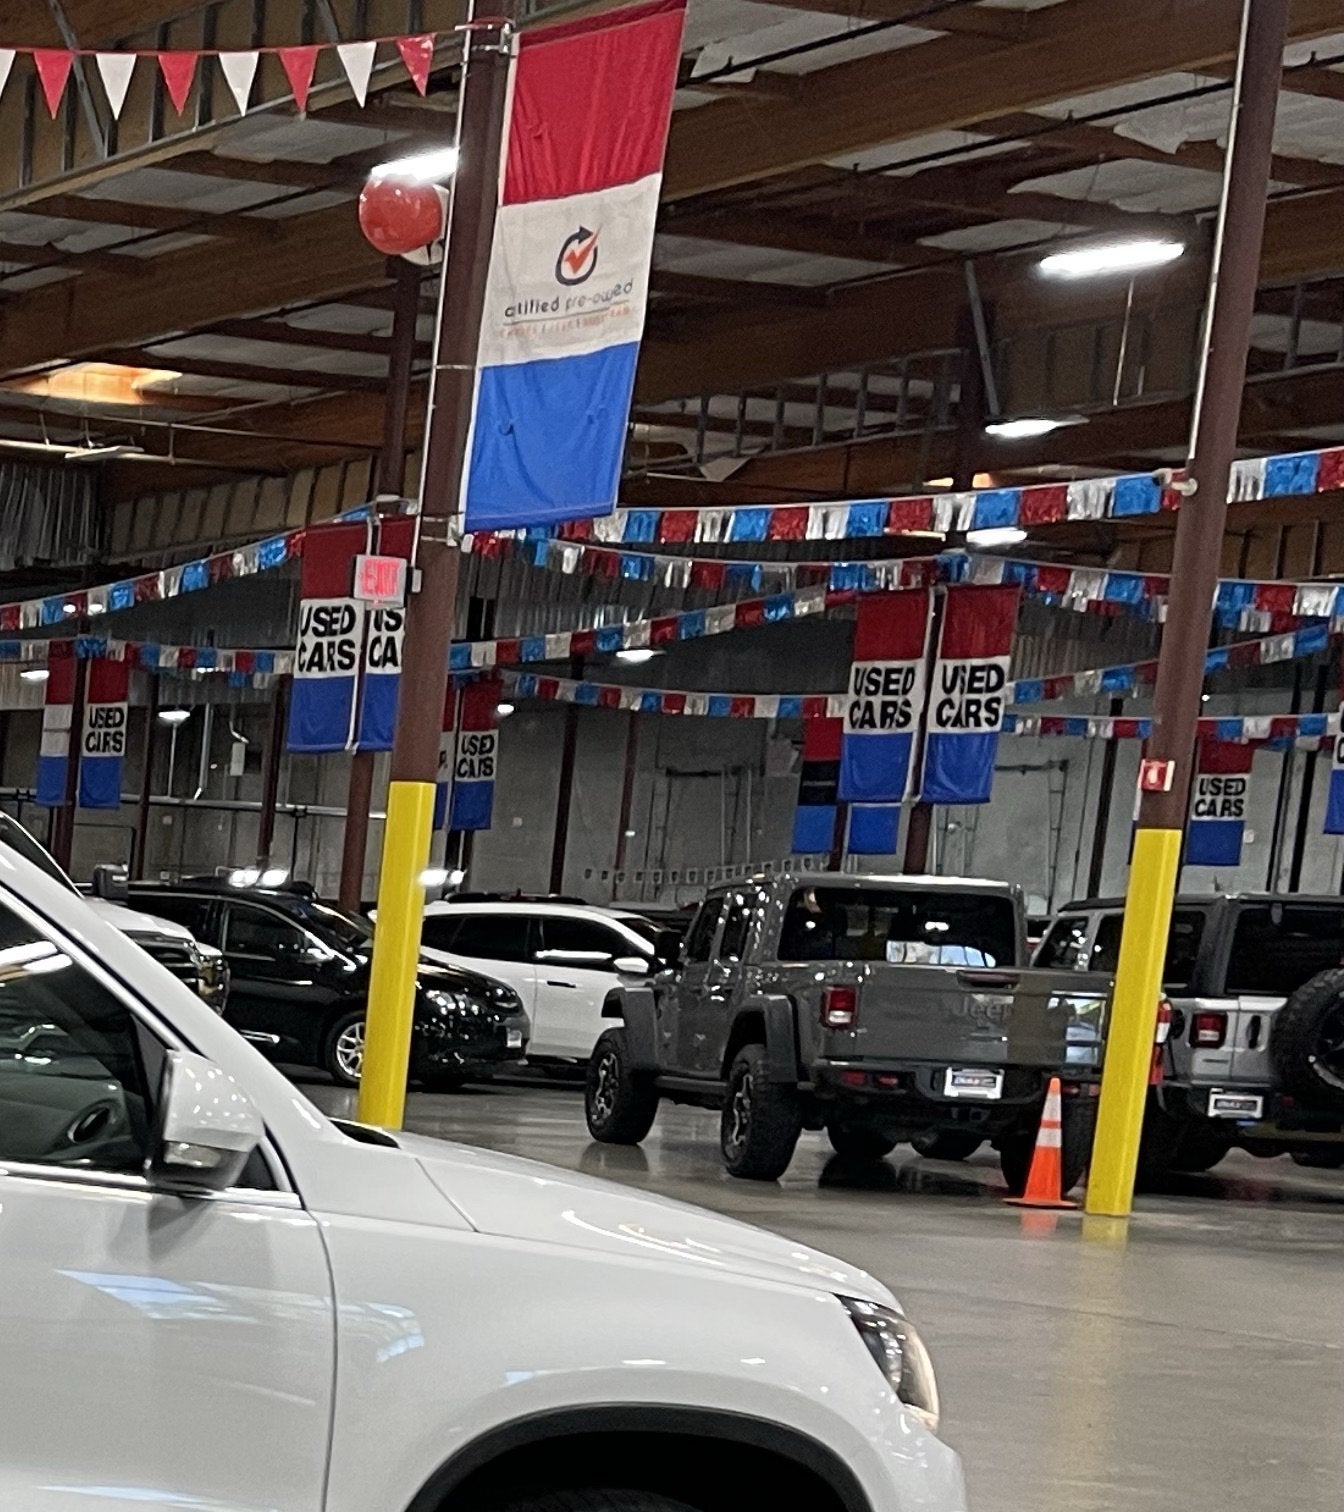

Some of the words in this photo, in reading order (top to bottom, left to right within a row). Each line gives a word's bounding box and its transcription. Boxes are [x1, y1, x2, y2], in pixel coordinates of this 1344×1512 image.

[300, 604, 357, 637] USED
[374, 610, 403, 632] US
[297, 638, 356, 672] CARS
[368, 635, 399, 668] CA
[854, 666, 916, 696] USED
[89, 707, 125, 728] USED
[848, 699, 912, 729] CARS
[935, 696, 1001, 728] CARS
[461, 734, 495, 756] USED
[1199, 777, 1247, 796] USED
[1195, 799, 1244, 817] CARS
